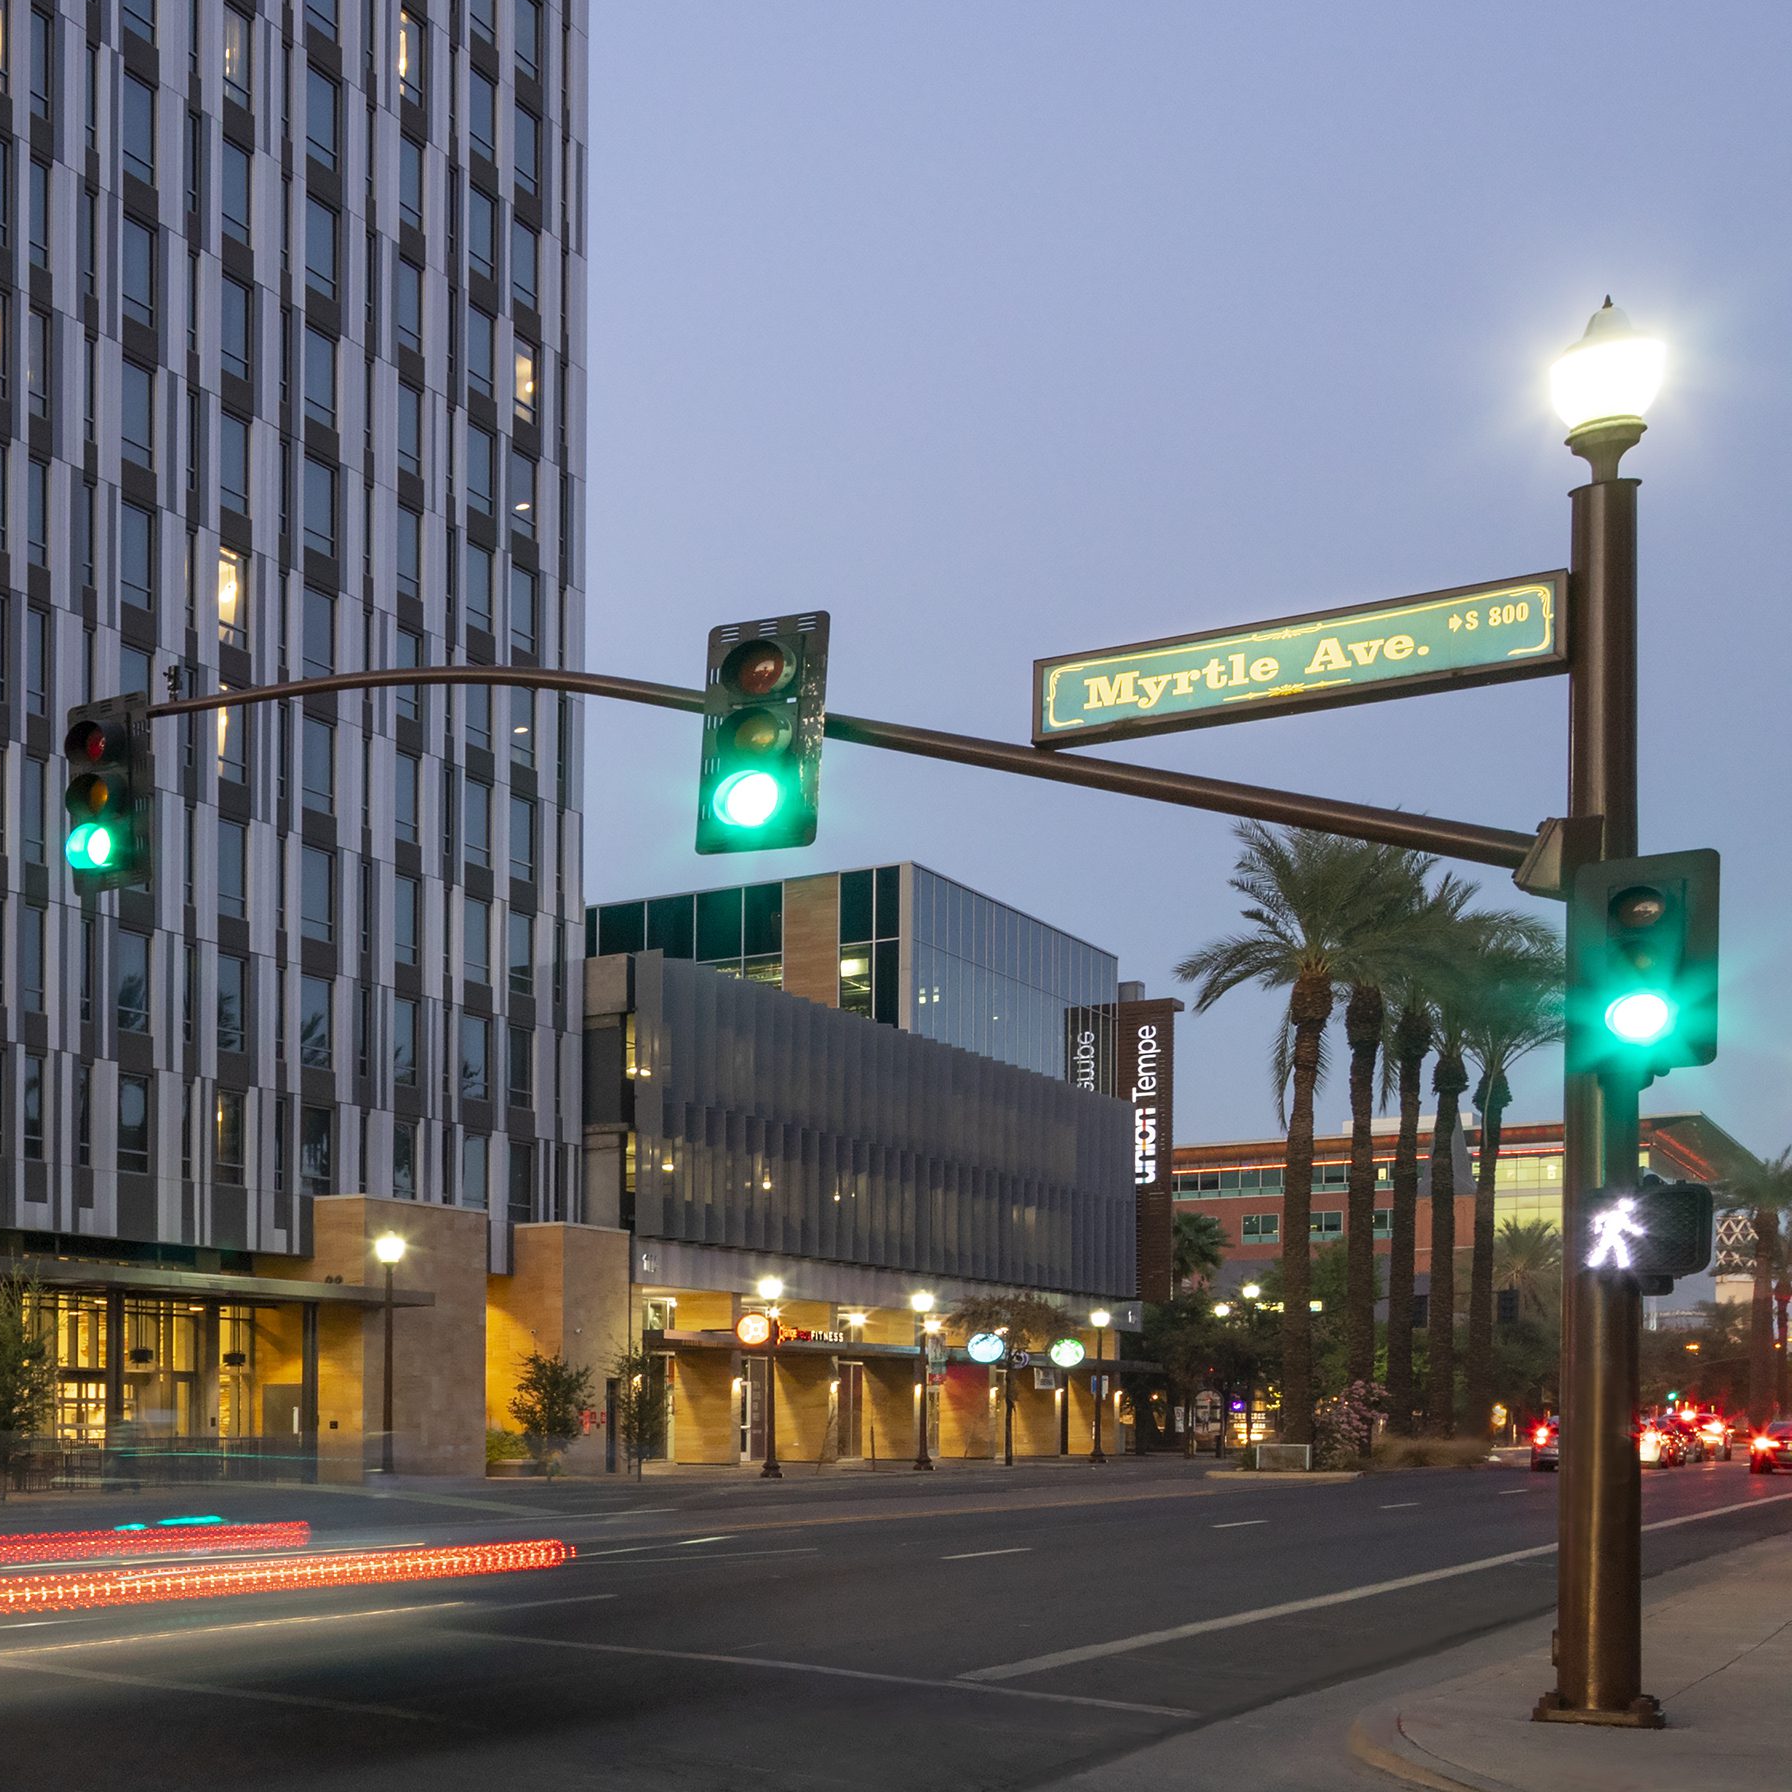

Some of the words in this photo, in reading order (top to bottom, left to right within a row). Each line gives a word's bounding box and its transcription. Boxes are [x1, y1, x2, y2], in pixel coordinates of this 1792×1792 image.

[1465, 610, 1479, 631] S
[1488, 601, 1529, 626] 800
[1083, 653, 1279, 710] Myrtle
[1305, 633, 1430, 675] Ave.
[1132, 1025, 1161, 1103] Tempe
[1134, 1107, 1156, 1184] union
[811, 1330, 844, 1343] FITNESS
